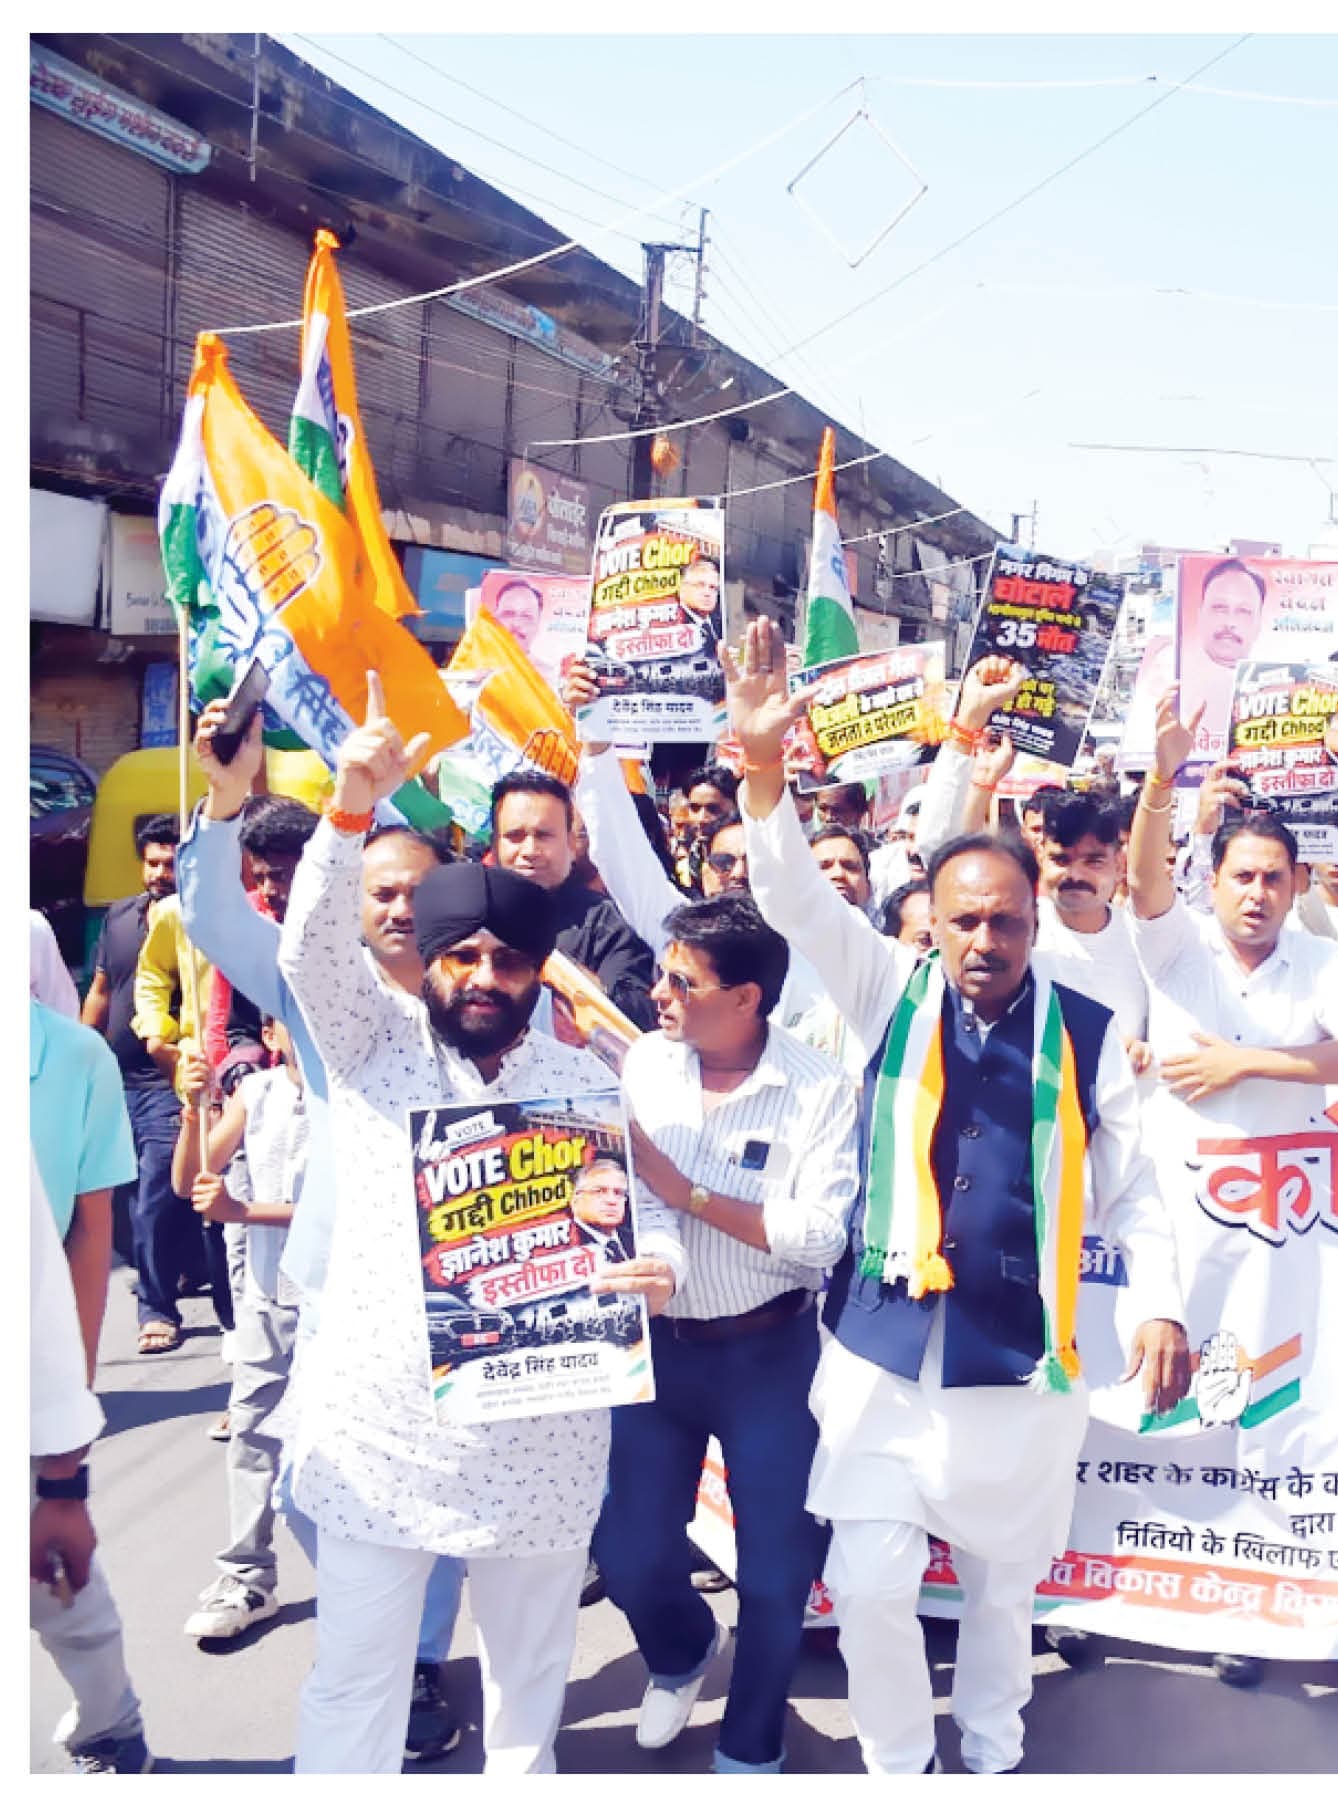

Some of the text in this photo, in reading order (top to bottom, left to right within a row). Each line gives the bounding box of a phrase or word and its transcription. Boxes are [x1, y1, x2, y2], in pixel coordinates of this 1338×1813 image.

[600, 544, 641, 578] VOTE
[643, 536, 694, 568] Chor
[633, 573, 677, 594] Chhod
[993, 577, 1076, 612] घोटाले
[677, 625, 694, 648] दो
[996, 621, 1036, 648] 35
[1239, 691, 1290, 718] VOTE
[1281, 719, 1324, 738] Chhod
[1260, 768, 1336, 796] इस्तीफा दो
[453, 1119, 485, 1138] VOTE
[424, 1133, 585, 1200] VOTE Chor
[441, 1179, 566, 1232] गद्दी Chhod
[438, 1218, 571, 1281] ज्ञानेश कुमार
[481, 1251, 597, 1305] इस्तीफा दो
[1098, 1461, 1157, 1483] शहर
[1164, 1462, 1193, 1485] के
[1286, 1466, 1315, 1499] के
[1289, 1512, 1336, 1540] द्वारा
[1117, 1520, 1195, 1553] नितियो
[1201, 1526, 1226, 1556] के
[1233, 1532, 1322, 1572] खिलाफ
[1084, 1559, 1184, 1599] विकास
